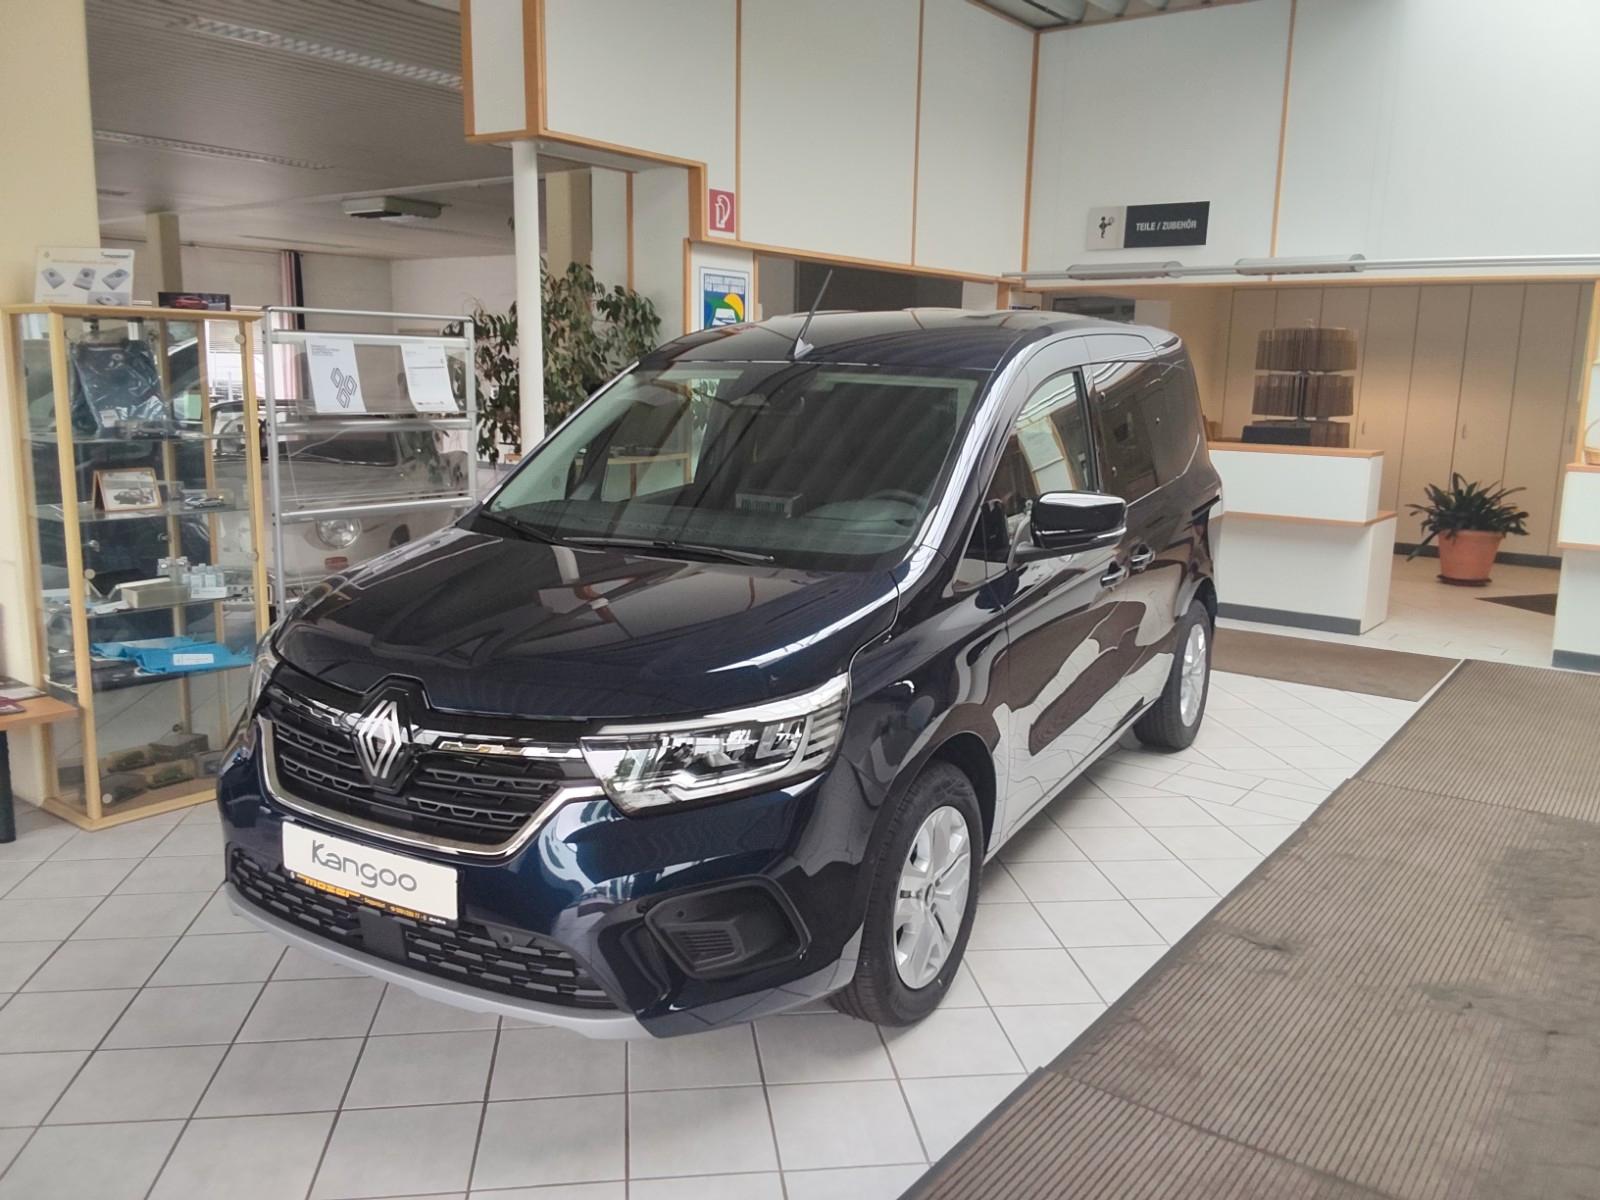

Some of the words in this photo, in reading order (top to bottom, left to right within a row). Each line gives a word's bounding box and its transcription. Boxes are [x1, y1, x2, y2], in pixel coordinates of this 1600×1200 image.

[1136, 222, 1156, 231] TEILE
[1162, 218, 1197, 230] ZUBEHÖR
[311, 839, 417, 892] Kangoo
